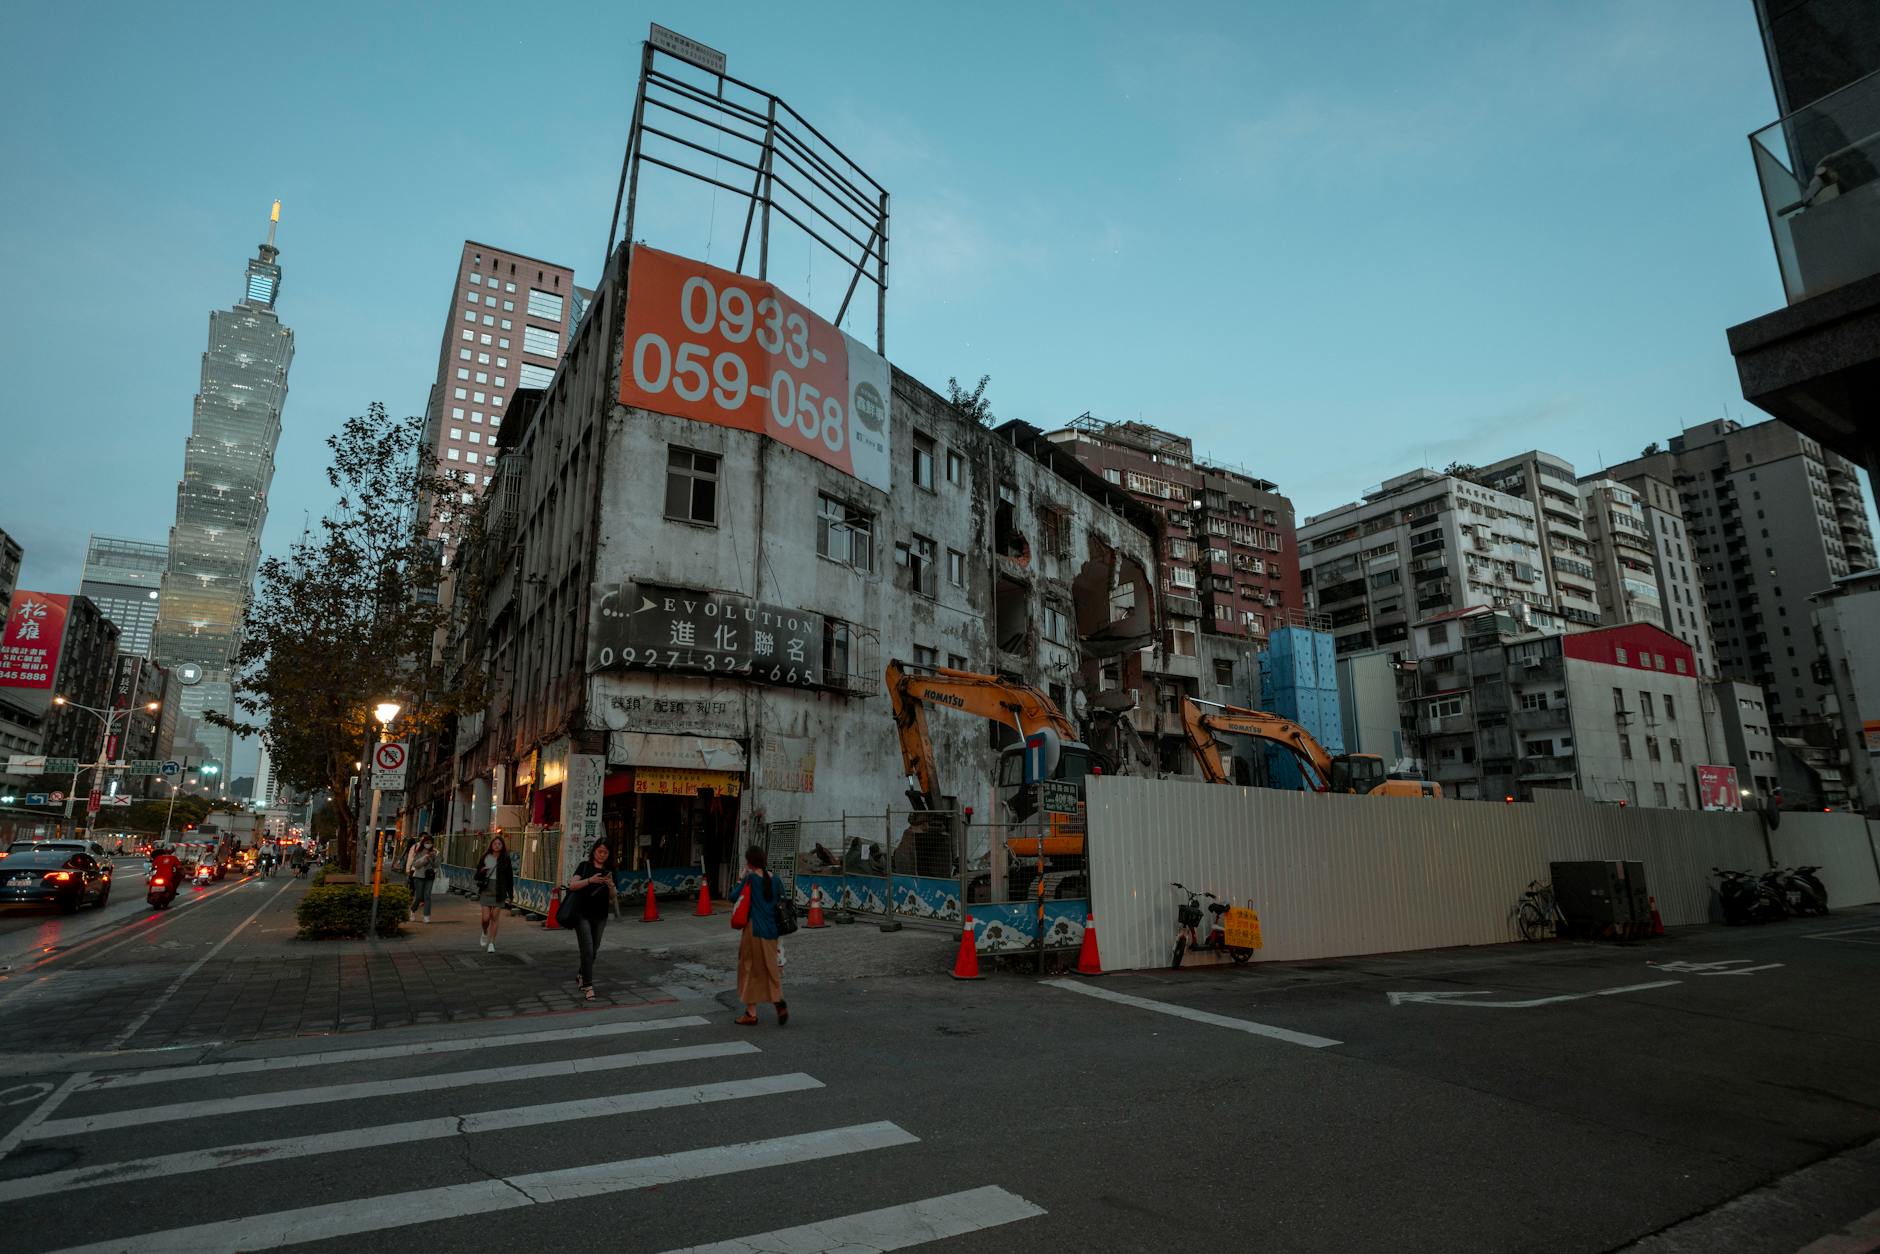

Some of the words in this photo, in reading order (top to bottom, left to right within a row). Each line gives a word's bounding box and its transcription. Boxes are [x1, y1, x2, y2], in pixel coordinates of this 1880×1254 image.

[680, 275, 828, 370] 0933-
[632, 332, 845, 453] 059-058
[663, 596, 814, 635] EVOLUTION
[670, 619, 805, 665] 進化聯名
[19, 671, 48, 681] 5888
[924, 688, 964, 708] KOMATSU
